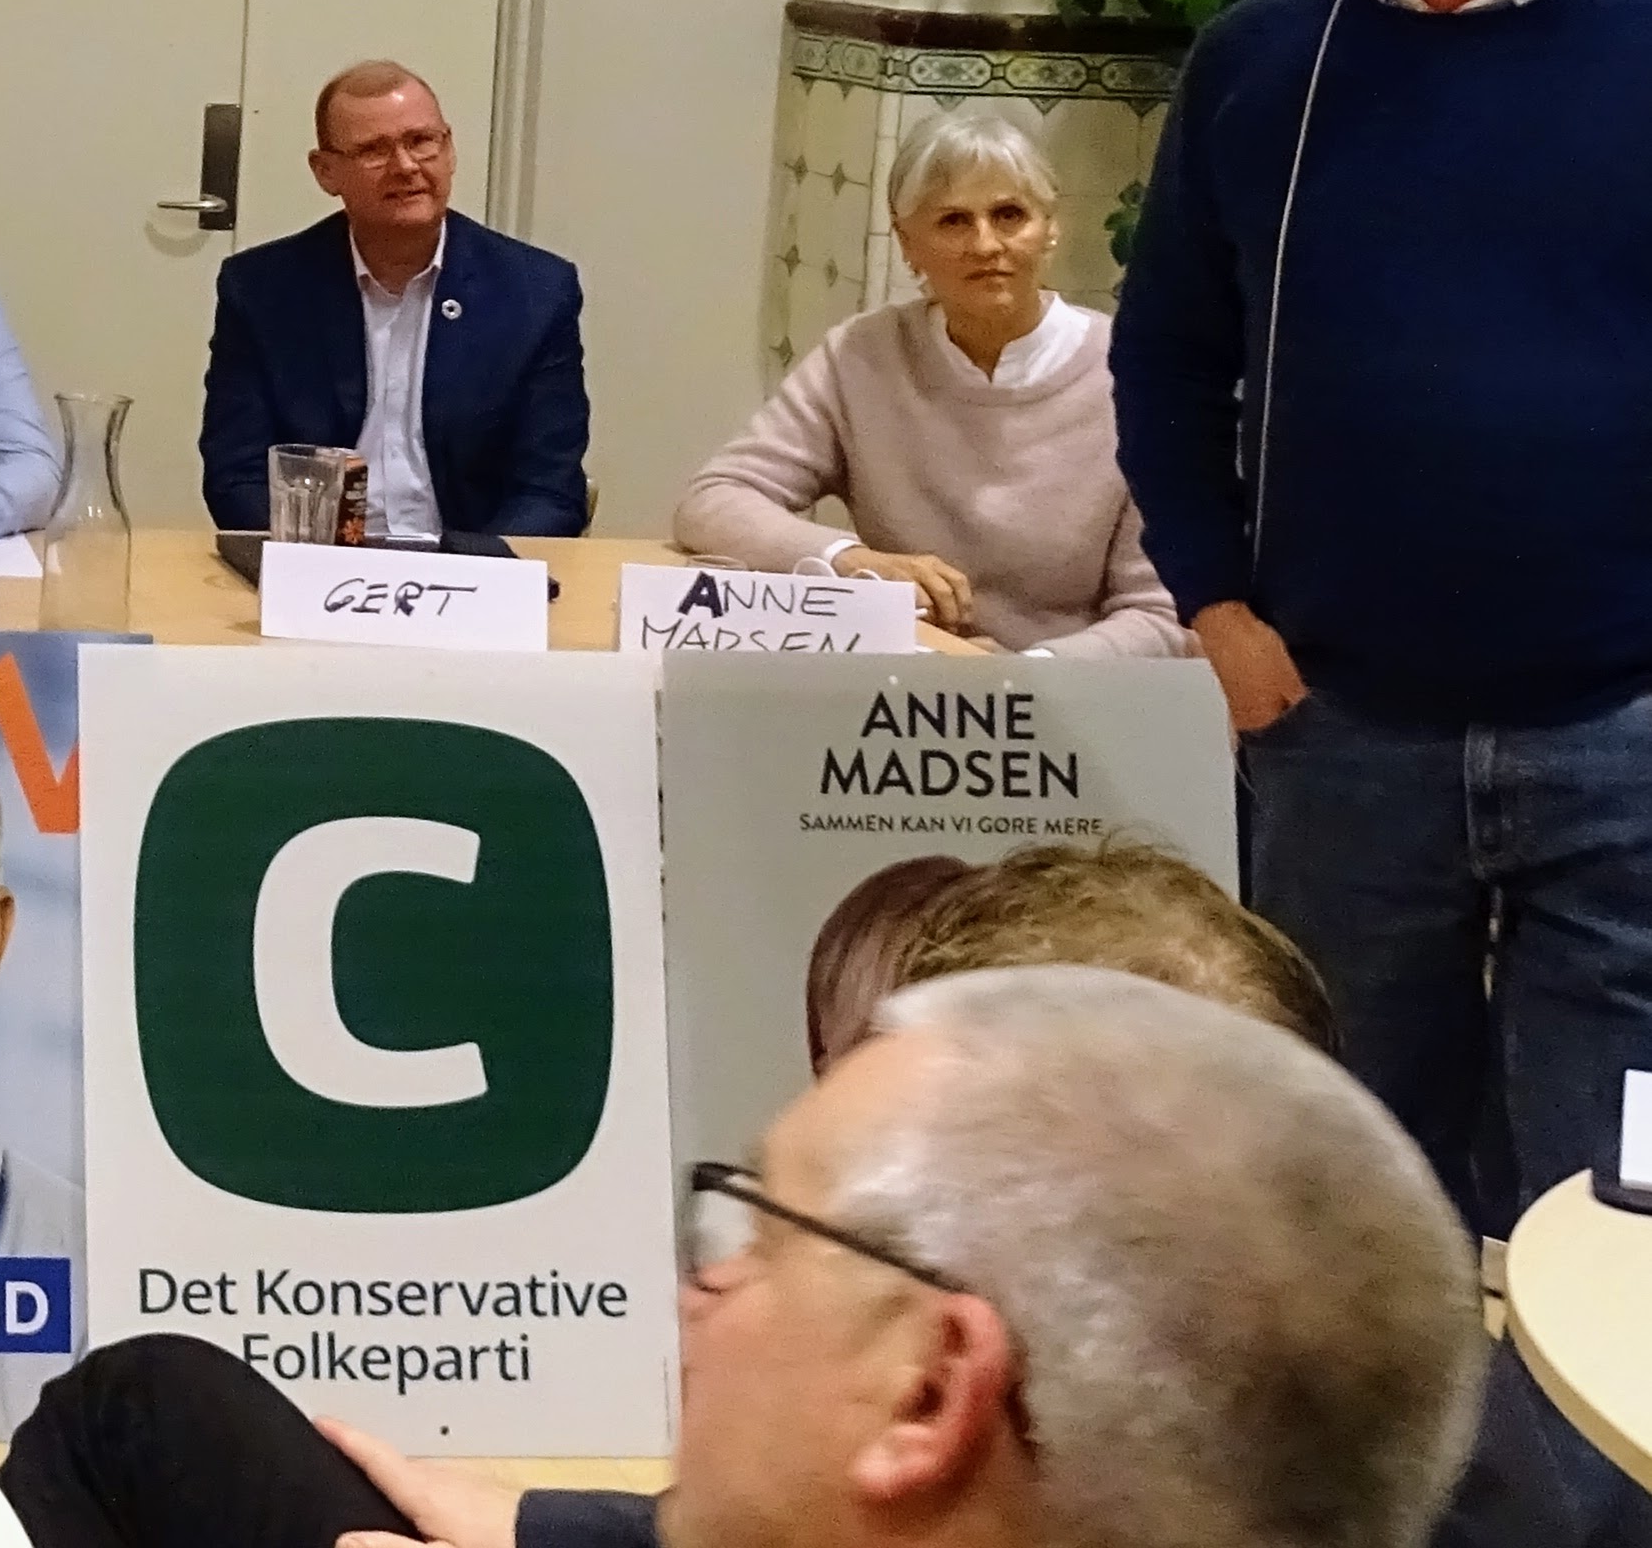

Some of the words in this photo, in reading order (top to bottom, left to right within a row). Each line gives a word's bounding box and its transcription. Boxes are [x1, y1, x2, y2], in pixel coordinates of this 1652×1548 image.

[323, 579, 477, 618] GERT
[677, 571, 855, 619] ANNE
[860, 690, 1035, 741] ANNE
[819, 747, 1080, 799] MADSEN
[799, 813, 895, 834] SAMMEN
[900, 815, 945, 834] KAN
[951, 817, 973, 833] VI
[1044, 818, 1104, 836] MERE
[253, 816, 489, 1104] C
[138, 1268, 239, 1318] Det
[257, 1268, 627, 1319] Konservative
[242, 1332, 531, 1394] Folkeparti
